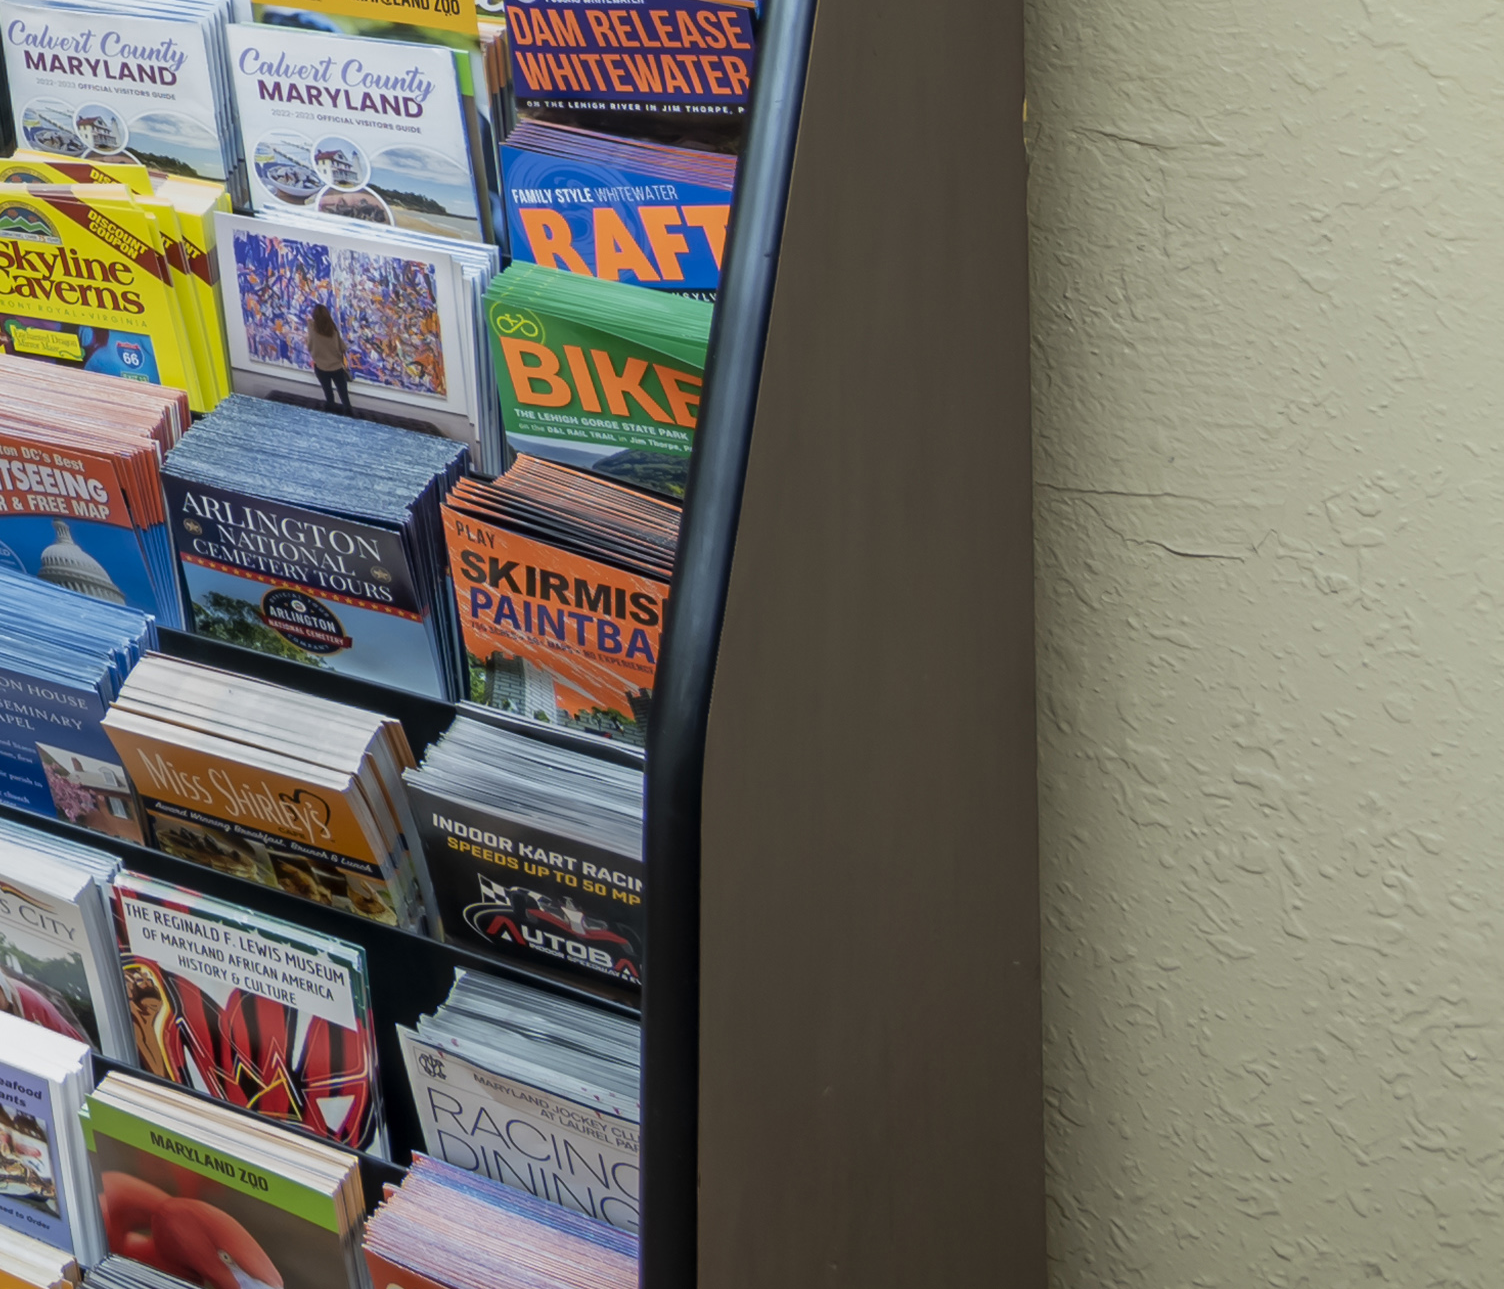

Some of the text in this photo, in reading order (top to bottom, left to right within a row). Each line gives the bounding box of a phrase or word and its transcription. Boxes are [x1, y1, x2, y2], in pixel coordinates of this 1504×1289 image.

[8, 19, 188, 73] Calvert County
[506, 5, 751, 50] DAM RELEASE
[24, 50, 177, 86] MARYLAND
[515, 51, 750, 95] WHITEWATER
[512, 185, 678, 204] FAMILY STYLE WHITEWATER
[88, 209, 149, 254] DISCOUNT
[88, 222, 138, 258] COUPON
[123, 352, 140, 365] 66
[514, 408, 688, 440] THE LEHIGH GORGE STATE PARK
[183, 491, 381, 562] ARLINGTON
[456, 520, 495, 549] PLAY
[193, 538, 393, 602] CEMETERY TOURS
[217, 524, 355, 576] NATIONAL
[18, 905, 76, 941] CITY
[124, 902, 345, 986] THE REGINALD F. LEWIS MUSEUM
[142, 927, 335, 1001] OF MARYLAND AFRICAN AMERICA
[177, 956, 297, 1005] HISTORY & CULTURE
